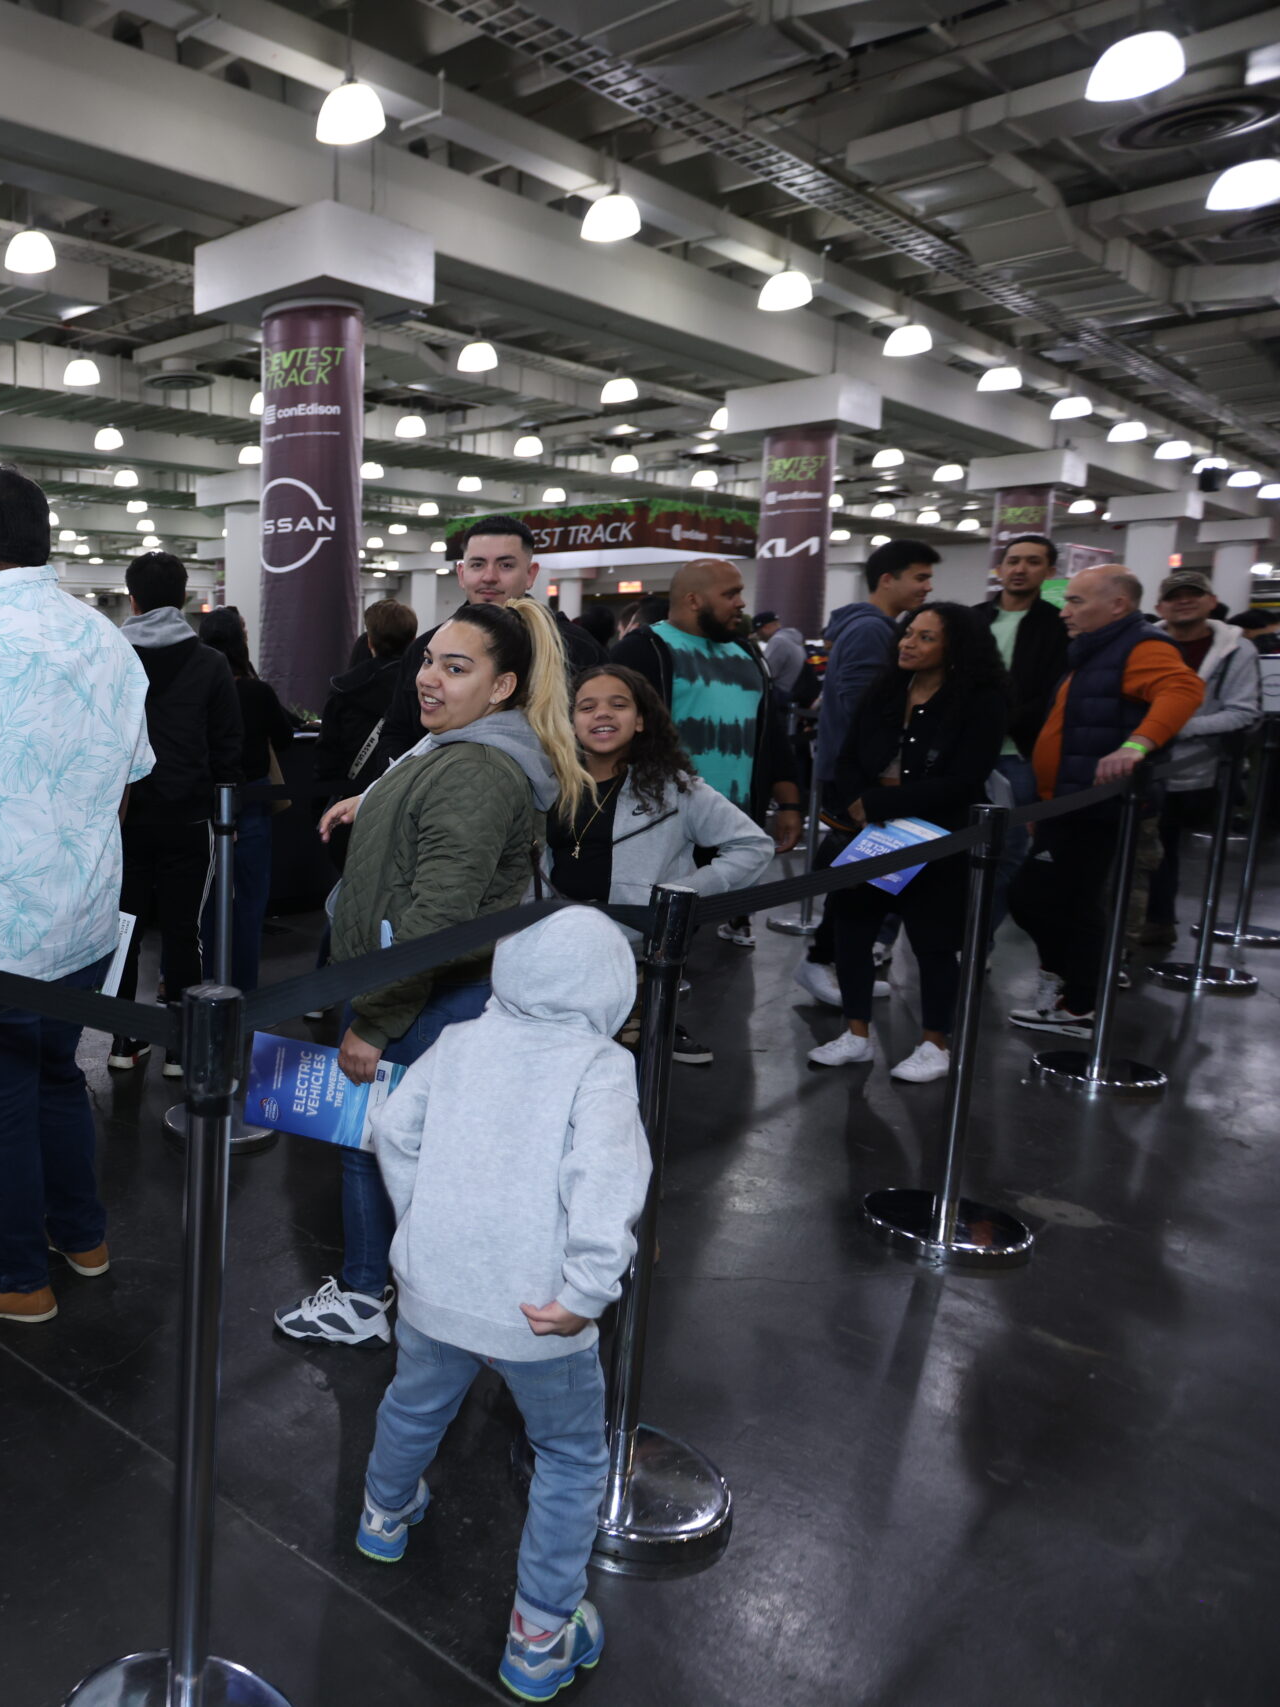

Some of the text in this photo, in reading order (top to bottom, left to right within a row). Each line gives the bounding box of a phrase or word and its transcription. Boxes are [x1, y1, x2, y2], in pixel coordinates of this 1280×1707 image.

[266, 367, 332, 390] TRACK
[277, 403, 341, 419] conEdison
[568, 521, 641, 545] TRACK
[293, 1050, 312, 1113] ELECTRIC
[306, 1053, 326, 1117] VEHICLES
[333, 1090, 344, 1107] THE
